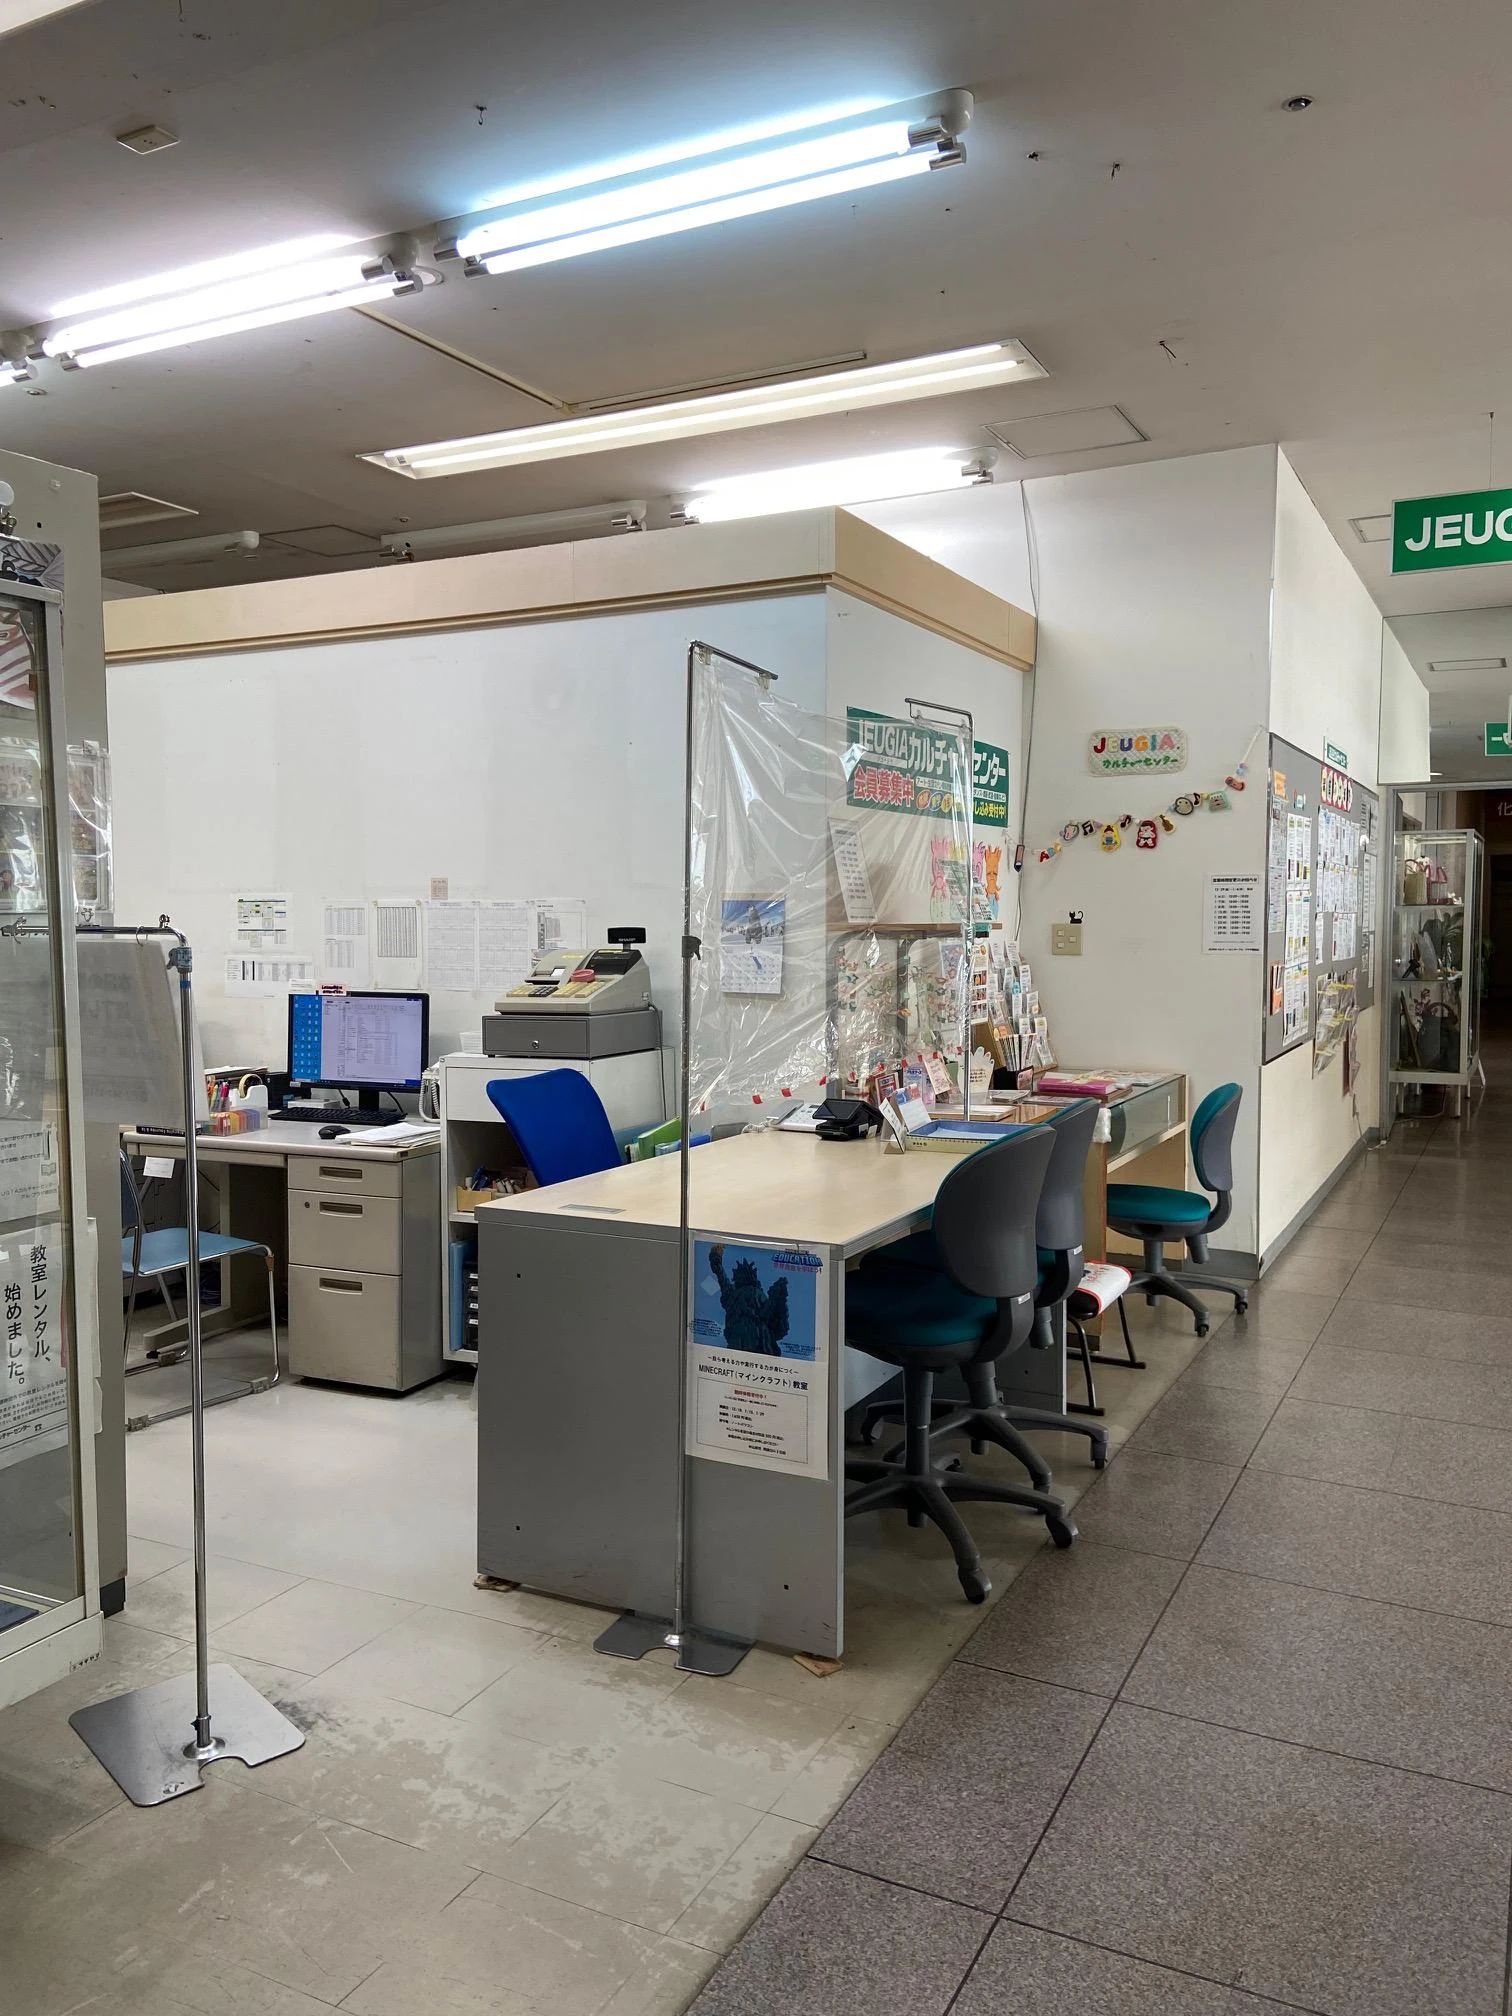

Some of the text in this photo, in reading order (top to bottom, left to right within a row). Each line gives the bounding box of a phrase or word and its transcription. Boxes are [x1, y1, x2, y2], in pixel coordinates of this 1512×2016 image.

[854, 765, 915, 807] 会員募集中
[4, 1283, 25, 1385] 始めました。
[30, 1245, 51, 1363] 教室レンタル、
